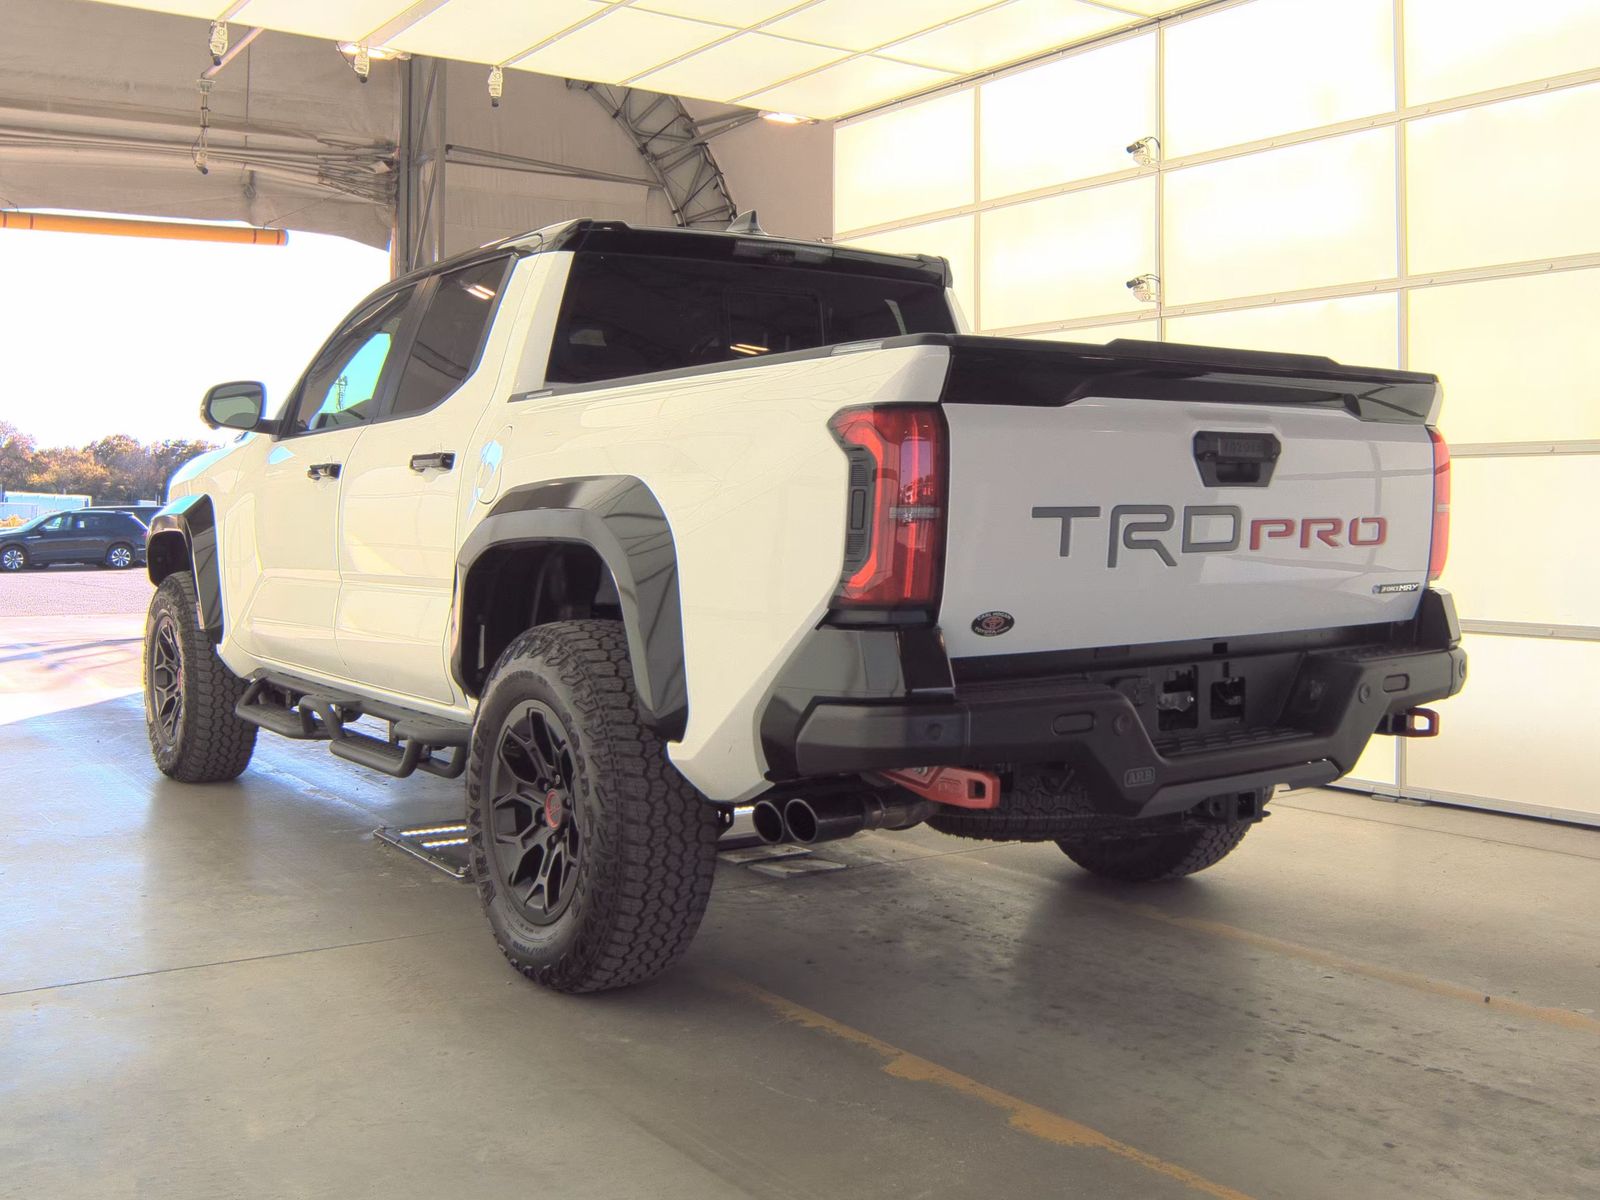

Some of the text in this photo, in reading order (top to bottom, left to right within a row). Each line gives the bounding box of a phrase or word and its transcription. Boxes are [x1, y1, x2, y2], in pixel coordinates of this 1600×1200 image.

[1031, 504, 1388, 568] TRD PRO
[1127, 769, 1152, 784] ARB
